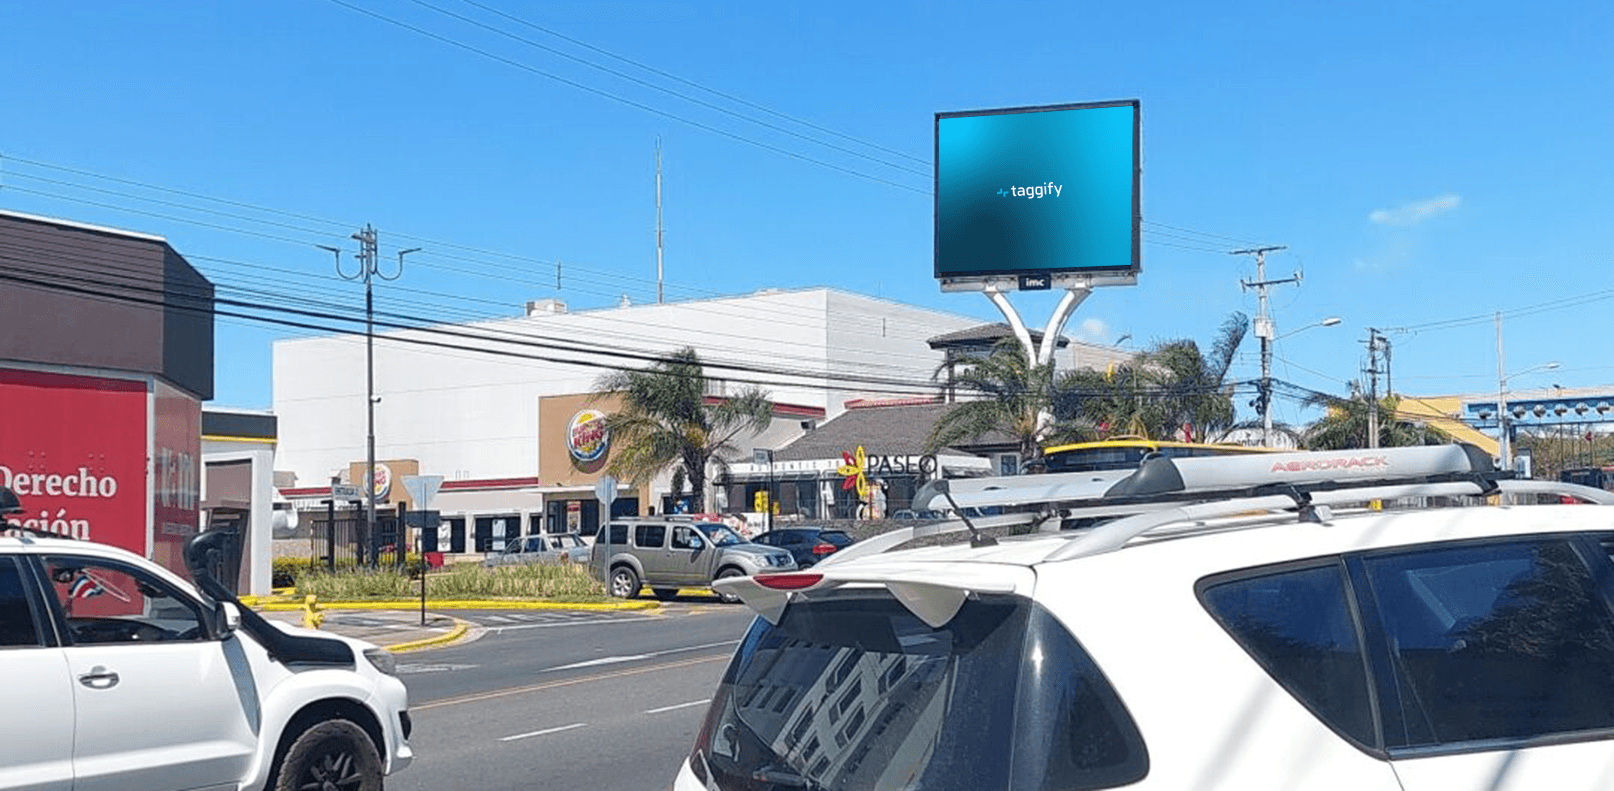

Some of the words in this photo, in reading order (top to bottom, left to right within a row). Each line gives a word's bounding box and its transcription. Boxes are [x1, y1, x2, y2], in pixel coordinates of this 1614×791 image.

[1010, 181, 1063, 199] taggify
[1025, 277, 1045, 287] imc
[867, 454, 938, 475] PASEO
